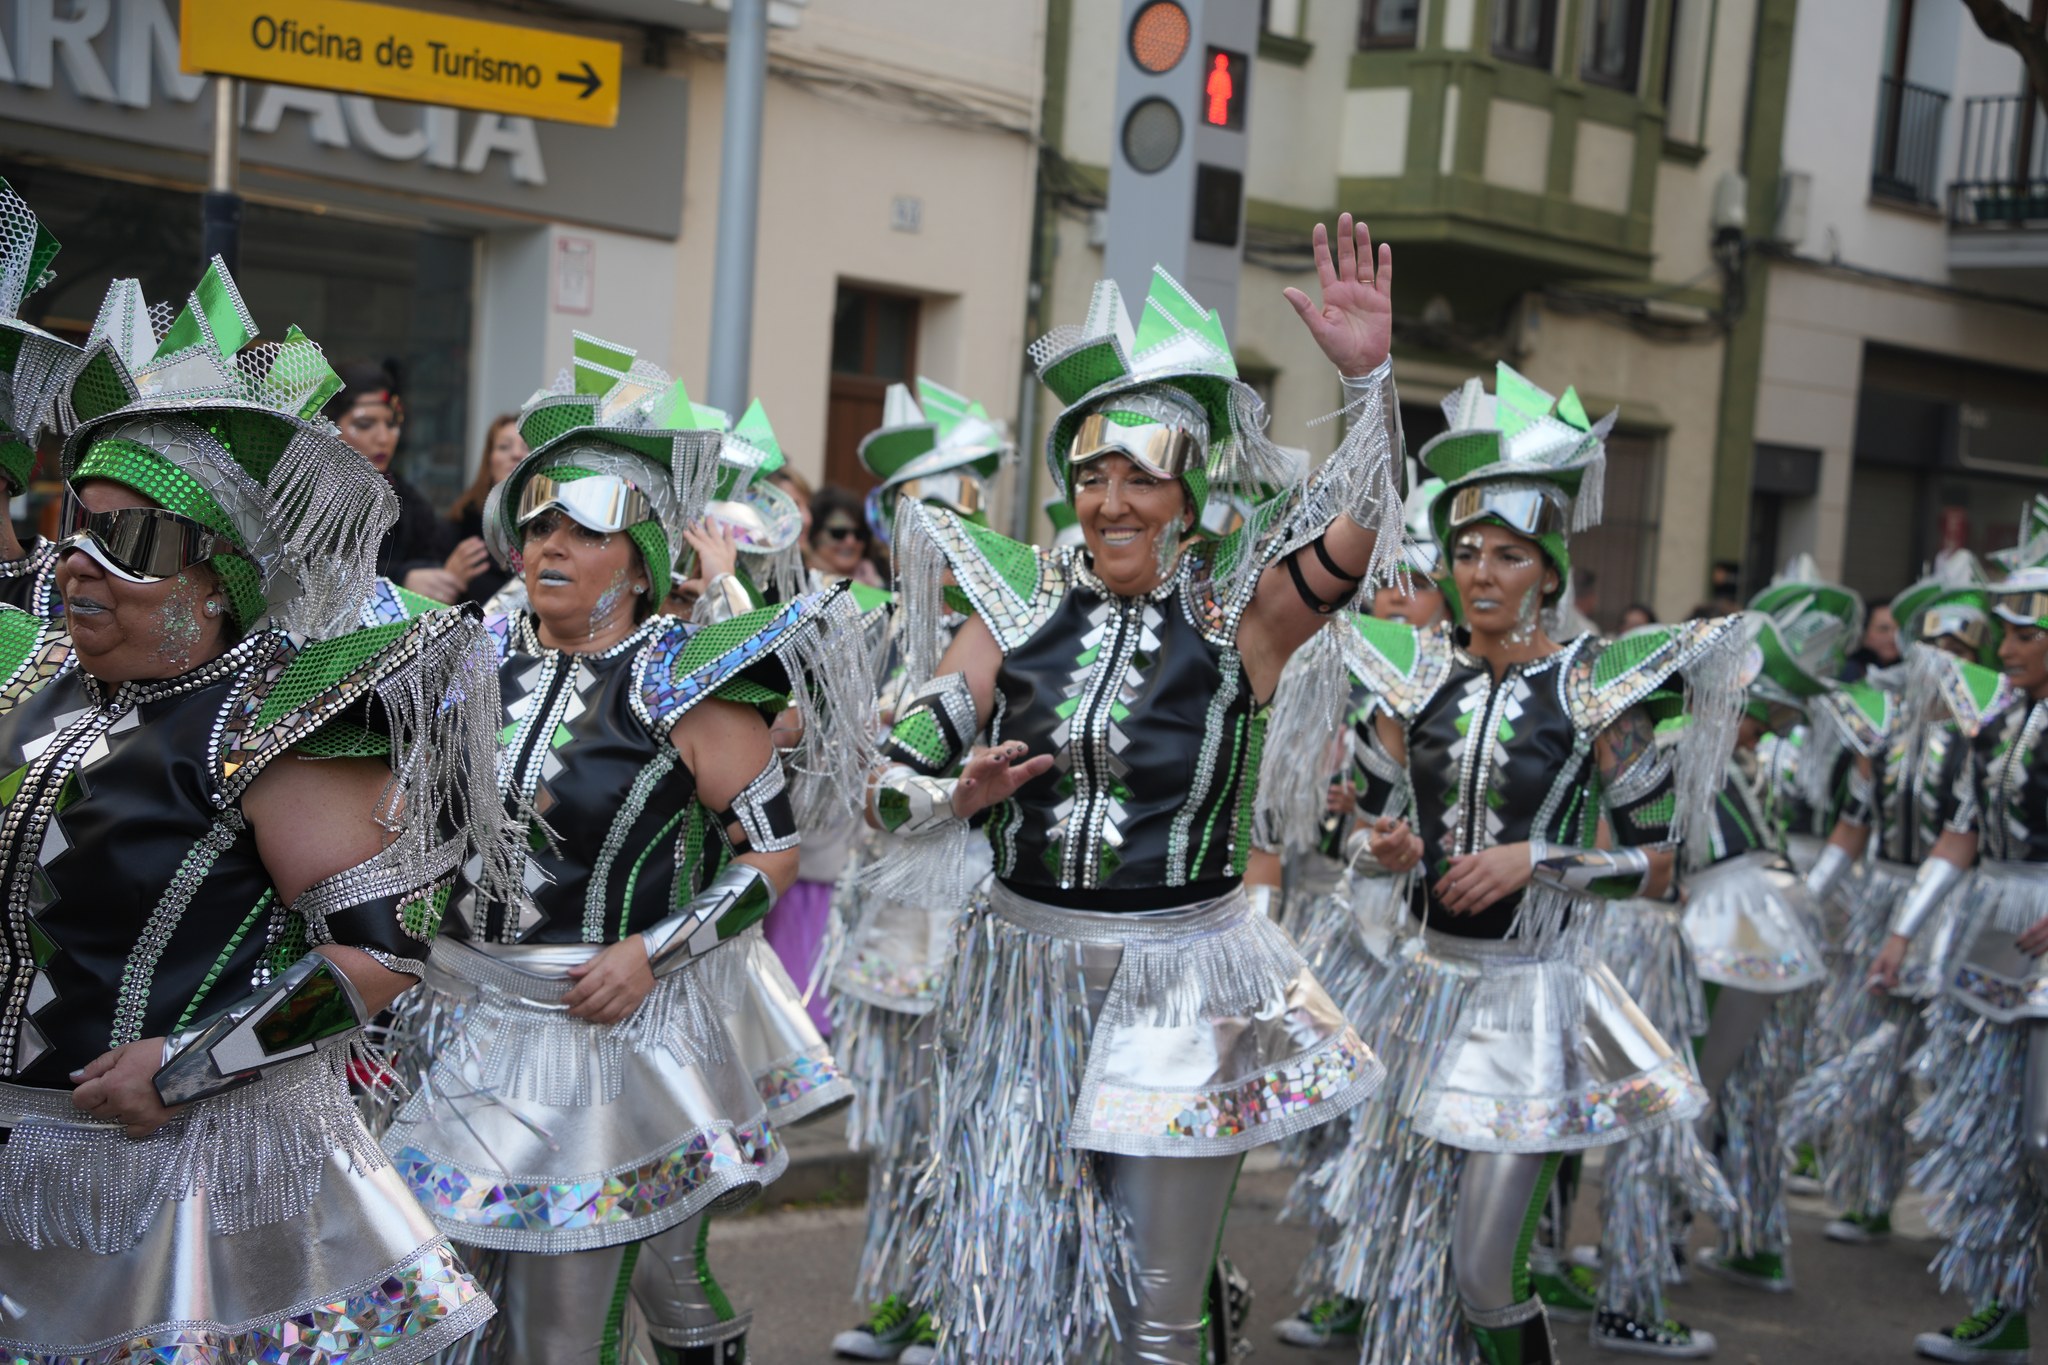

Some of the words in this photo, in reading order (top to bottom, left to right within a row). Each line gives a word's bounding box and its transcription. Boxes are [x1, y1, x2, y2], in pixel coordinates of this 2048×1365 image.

[0, 0, 547, 185] RMACIA
[251, 15, 363, 62] Oficina
[375, 36, 414, 69] de
[427, 41, 542, 89] Turismo
